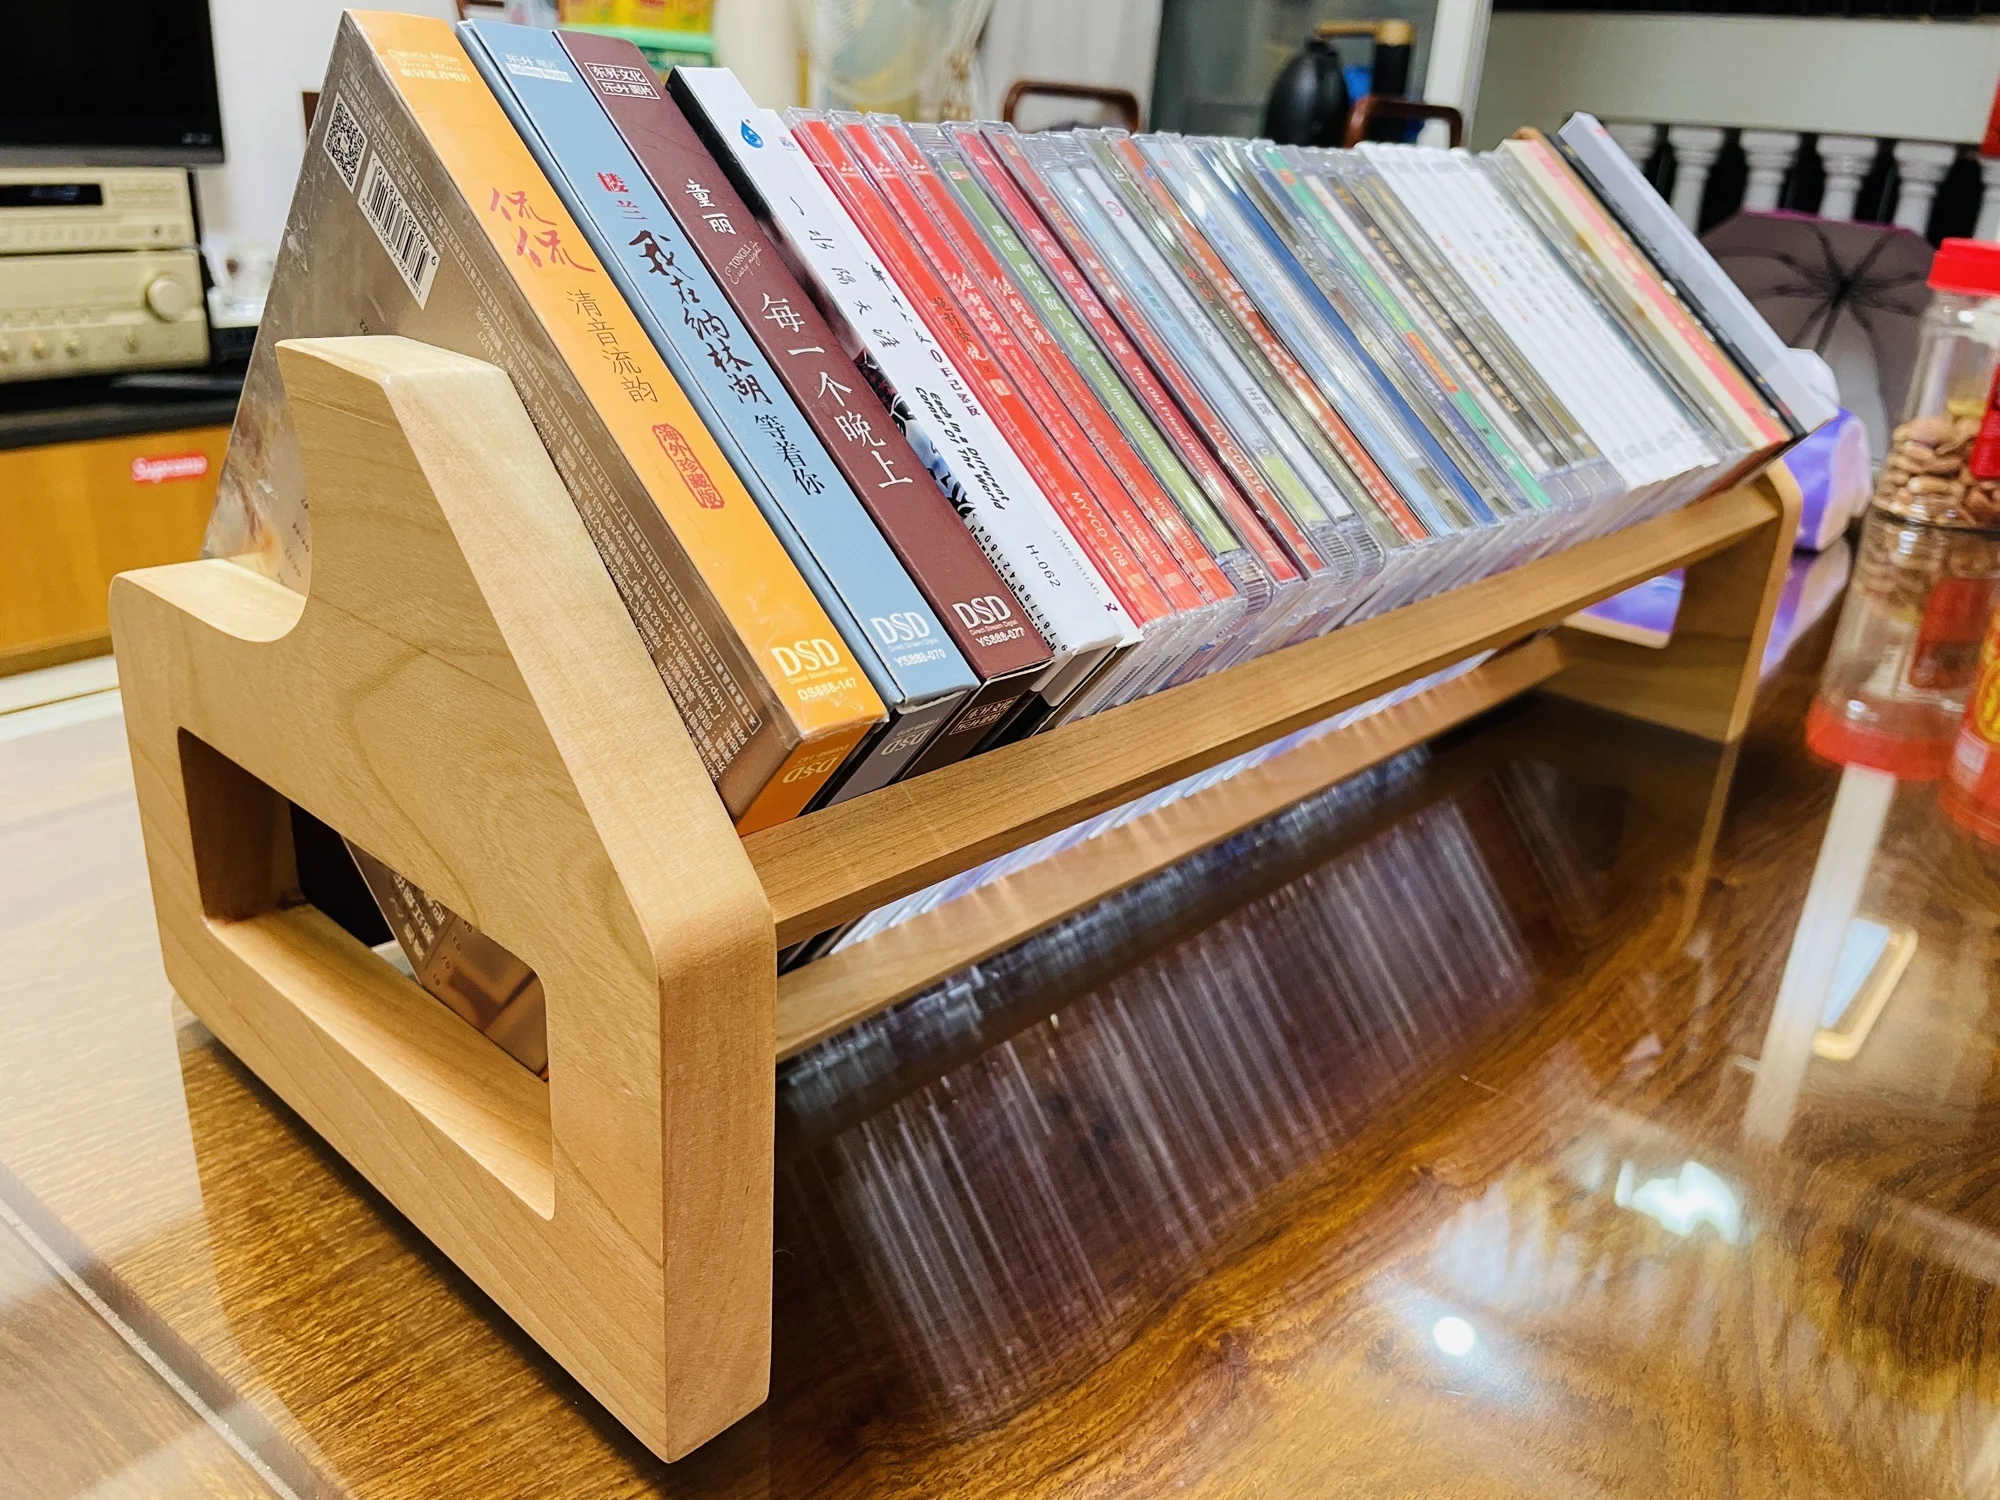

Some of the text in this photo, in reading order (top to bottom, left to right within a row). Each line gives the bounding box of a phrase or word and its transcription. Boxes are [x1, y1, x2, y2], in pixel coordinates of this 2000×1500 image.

[488, 187, 597, 273] 侃侃
[686, 178, 737, 235] 童丽
[789, 196, 899, 349] 一水隔天涯
[565, 289, 659, 404] 清音流韵
[761, 292, 913, 490] 每一个晚上
[1132, 365, 1148, 387] The
[1161, 405, 1189, 441] Friend
[754, 414, 826, 497] 等着你
[1210, 424, 1266, 494] FLYCD-036
[1071, 491, 1129, 567] MYYCD-108
[1121, 509, 1165, 565] MYYCD-102
[1025, 543, 1062, 588] H-062
[870, 612, 931, 645] DSD
[951, 595, 1012, 630] DSD
[975, 626, 1026, 648] YS888-077
[769, 638, 840, 678] DSD
[893, 649, 947, 668] YS888-070
[796, 676, 858, 702] DS888-147
[782, 755, 837, 785] DSD
[880, 729, 931, 757] DSD
